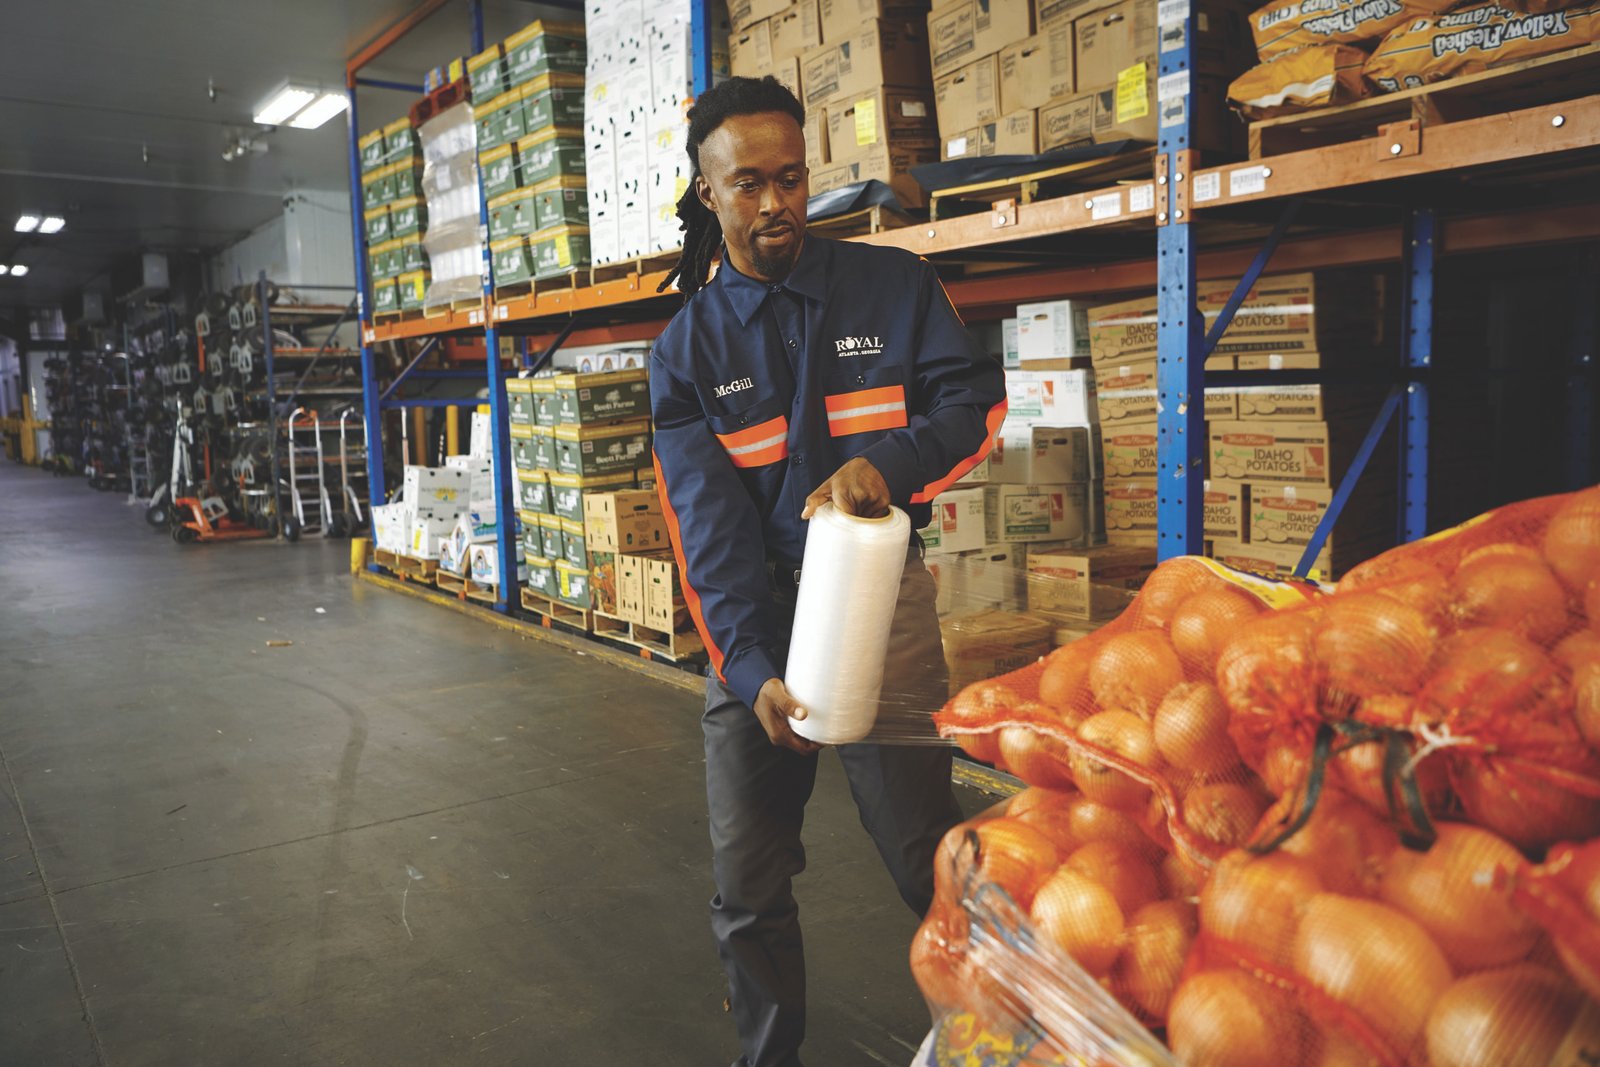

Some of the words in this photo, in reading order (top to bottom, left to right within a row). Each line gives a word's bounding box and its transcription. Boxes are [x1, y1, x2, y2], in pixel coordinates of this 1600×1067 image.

[1504, 12, 1569, 38] Yellow
[1433, 24, 1502, 56] Fleshed
[835, 336, 884, 352] ROYAL
[1121, 332, 1157, 347] POTATO
[713, 377, 754, 398] McGill
[1254, 448, 1292, 461] IDAHO
[1246, 460, 1301, 473] POTATOES
[1204, 506, 1231, 515] DAHO
[1287, 511, 1319, 524] IDAHO
[1280, 522, 1316, 533] POTATO
